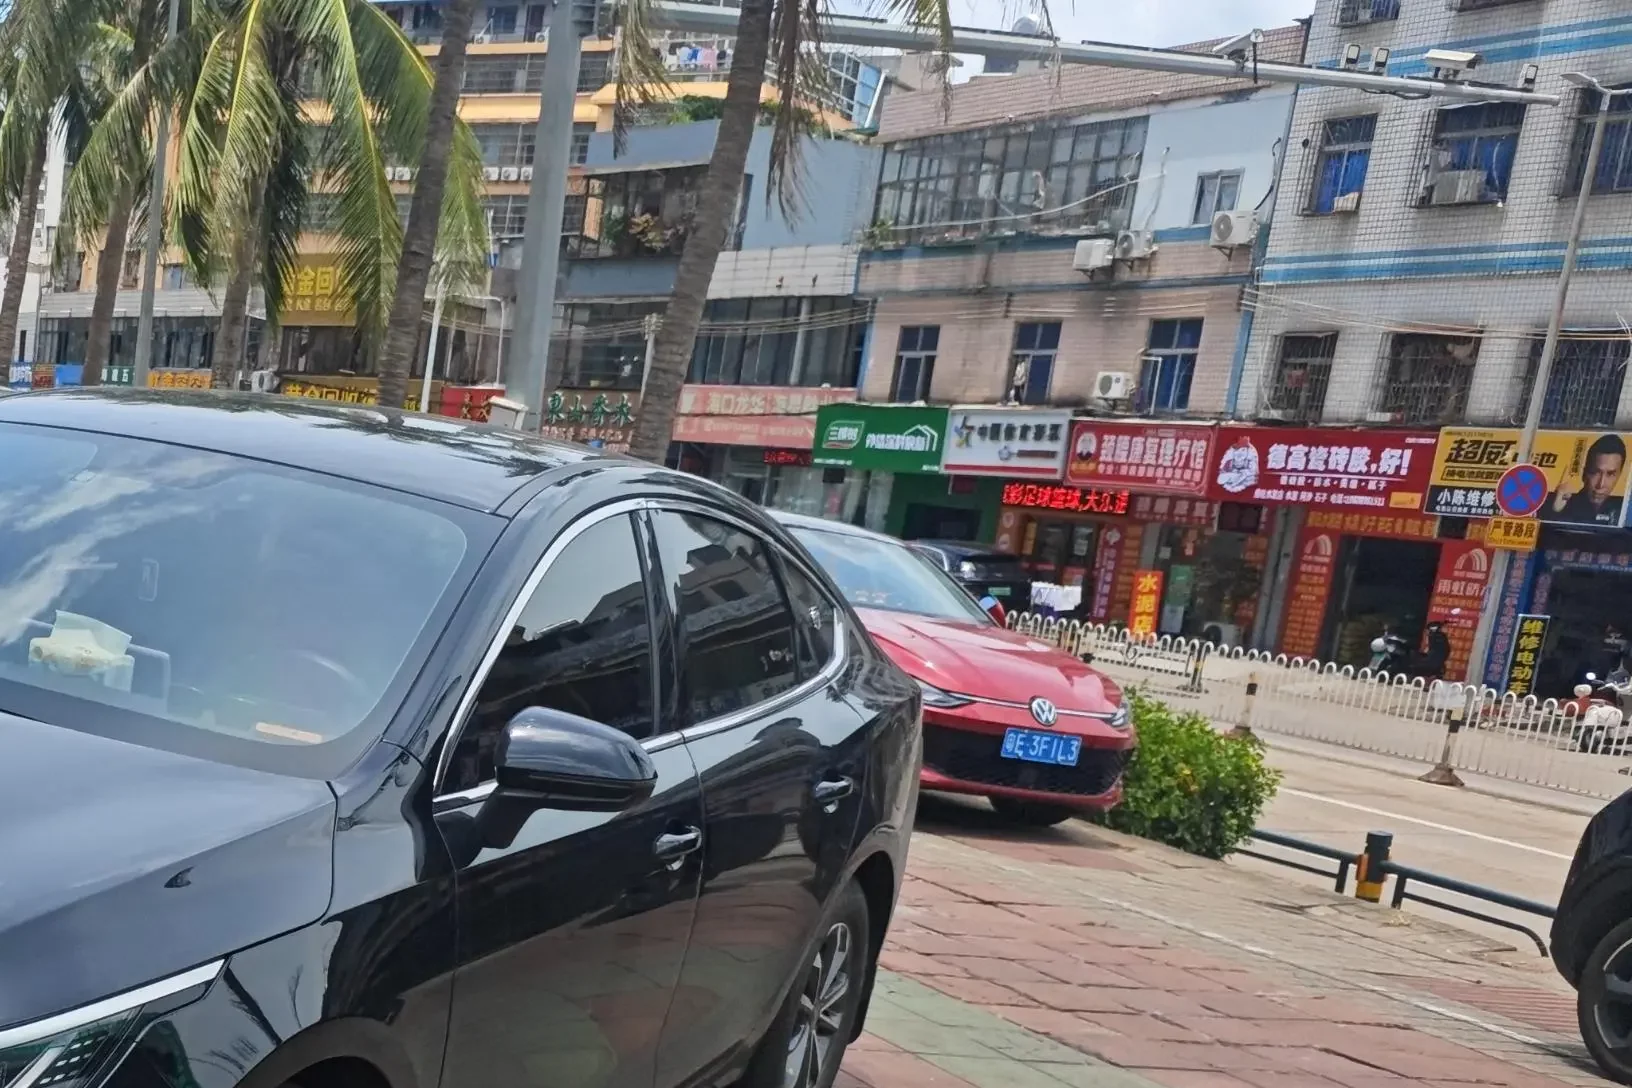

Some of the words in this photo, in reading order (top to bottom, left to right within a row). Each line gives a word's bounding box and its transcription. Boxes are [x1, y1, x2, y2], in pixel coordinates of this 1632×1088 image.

[1437, 487, 1496, 507] 小陈维修
[1491, 519, 1536, 539] 严管路段
[1507, 619, 1545, 696] 维修电动车
